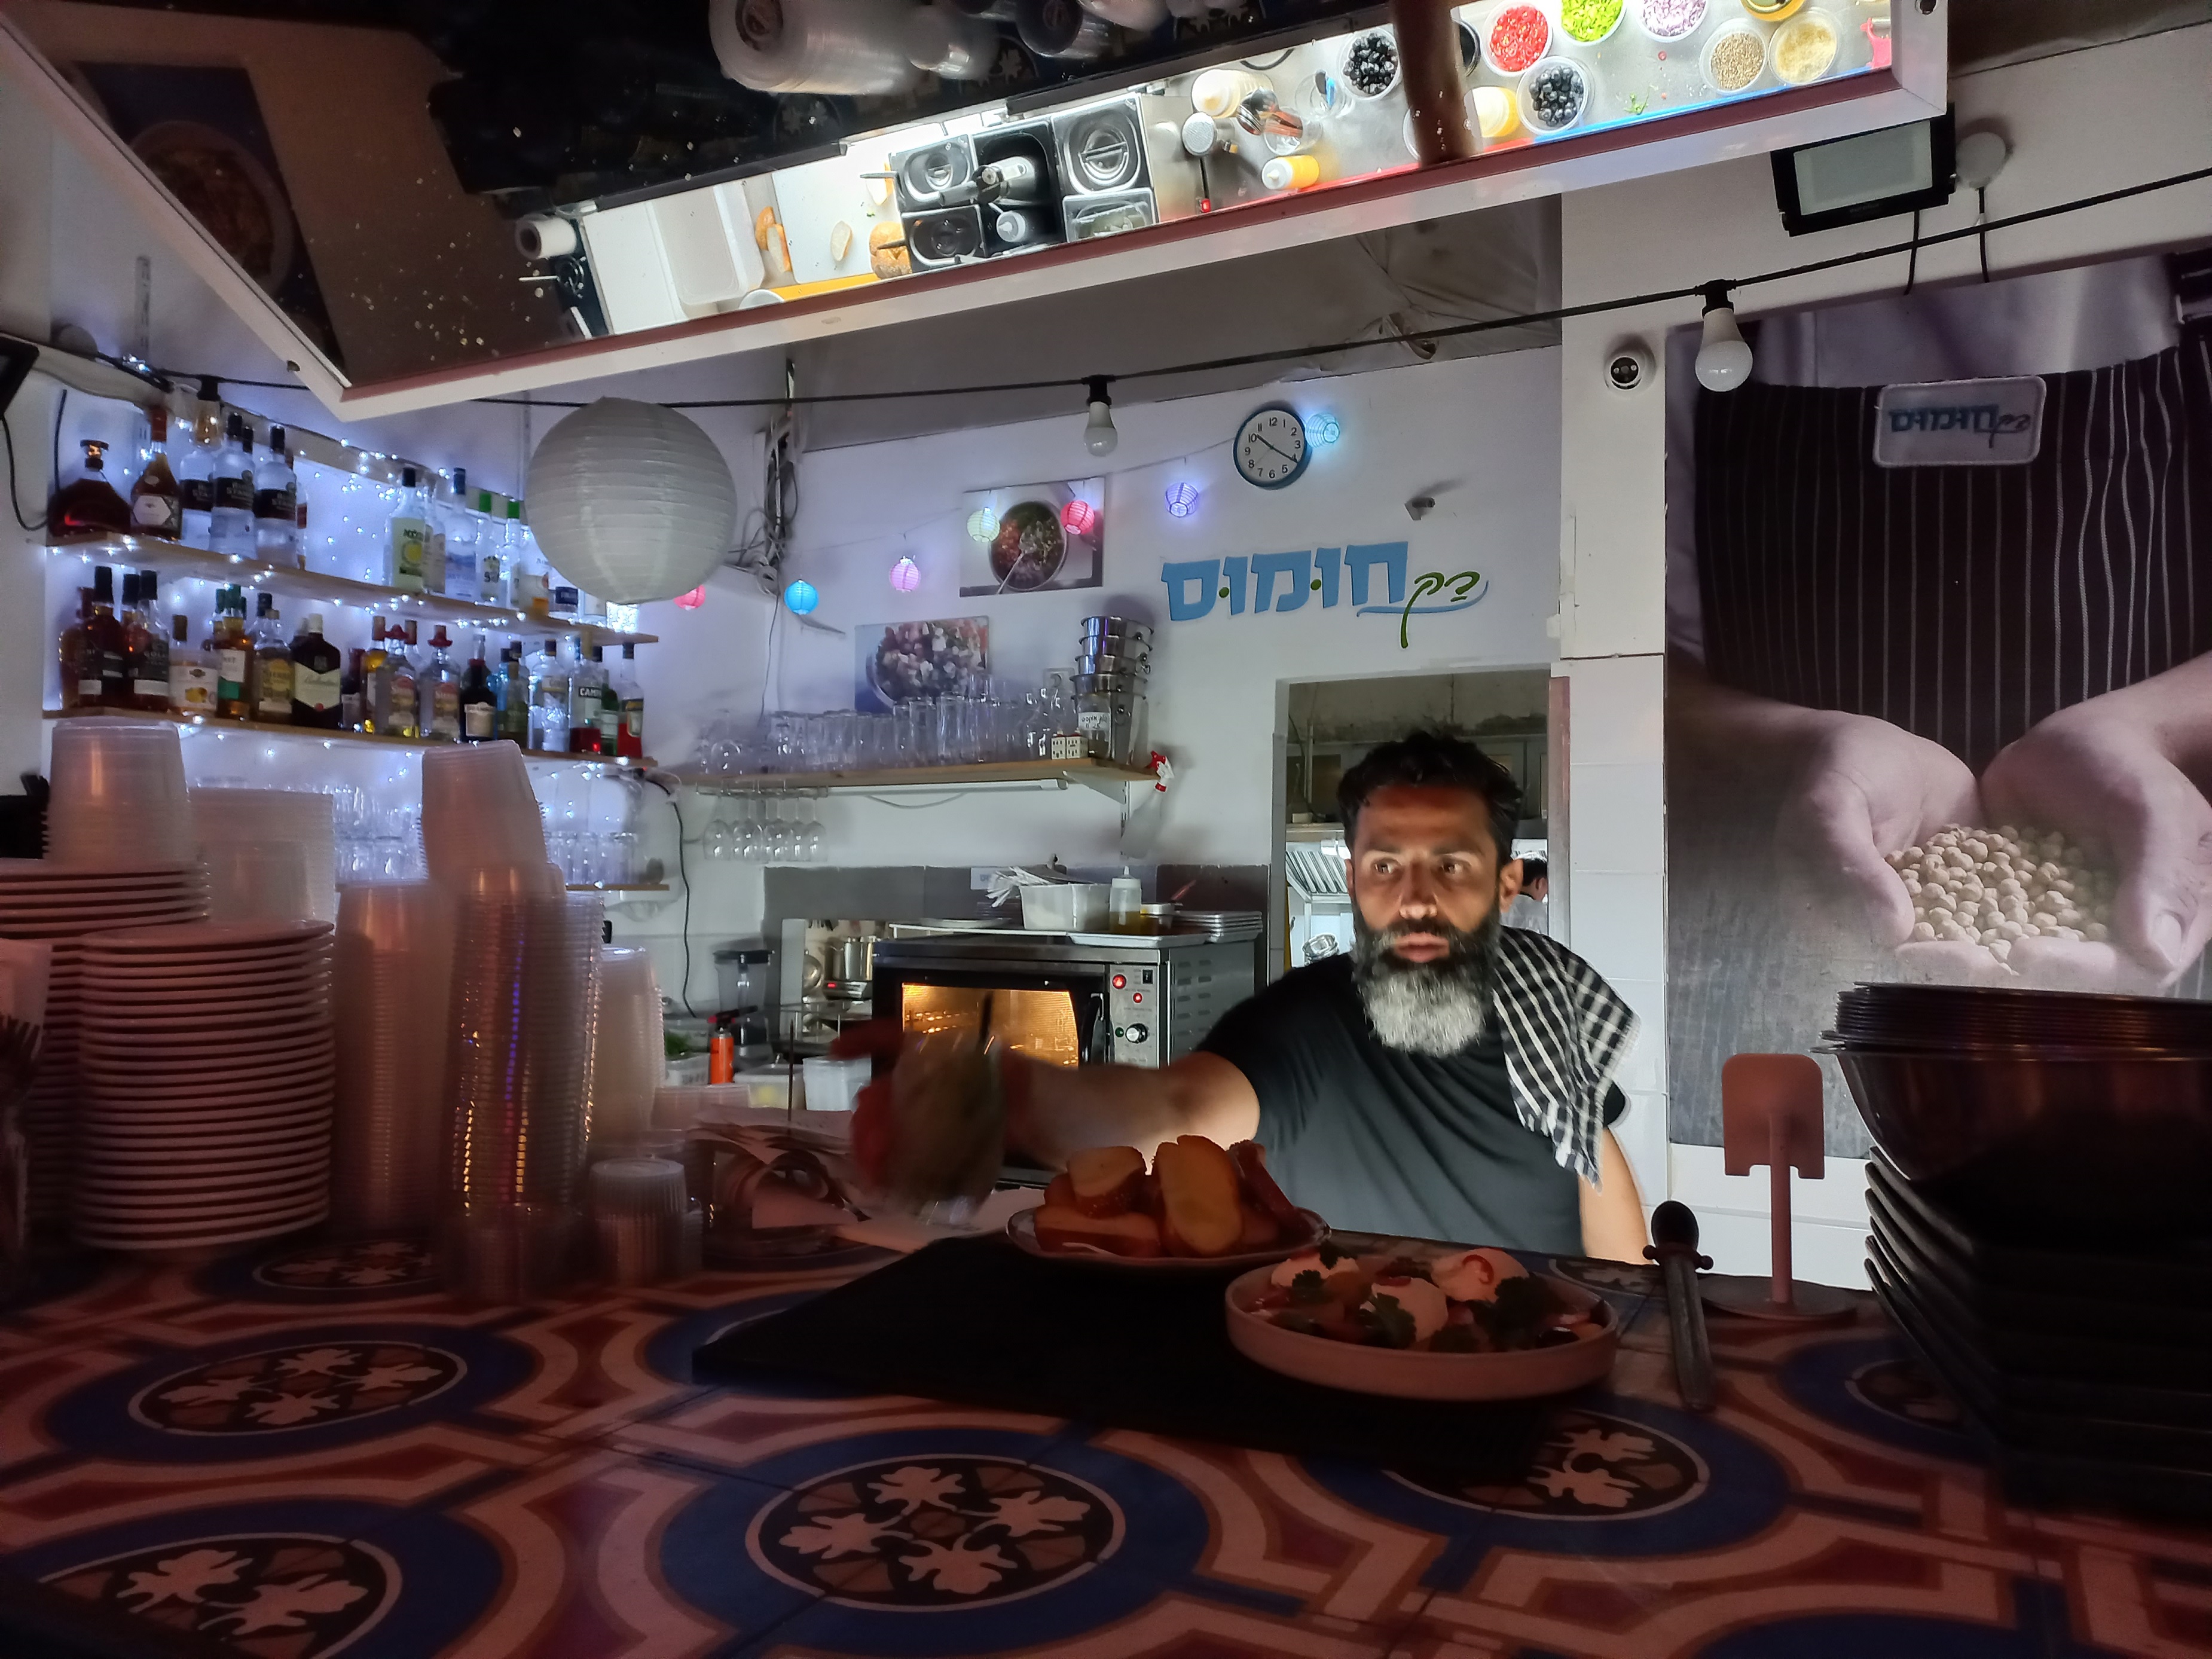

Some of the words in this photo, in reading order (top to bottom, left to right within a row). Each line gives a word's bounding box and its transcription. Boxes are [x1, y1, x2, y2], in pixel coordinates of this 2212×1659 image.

[1269, 417, 1278, 427] 12
[1257, 423, 1263, 432] 11
[1291, 427, 1297, 436] 2
[1248, 433, 1257, 443] 10
[1294, 440, 1301, 449] 3
[1244, 447, 1251, 456] 9
[1248, 459, 1255, 469] 8
[1257, 468, 1263, 477] 7
[1269, 469, 1275, 479] 6
[1282, 465, 1288, 474] 5
